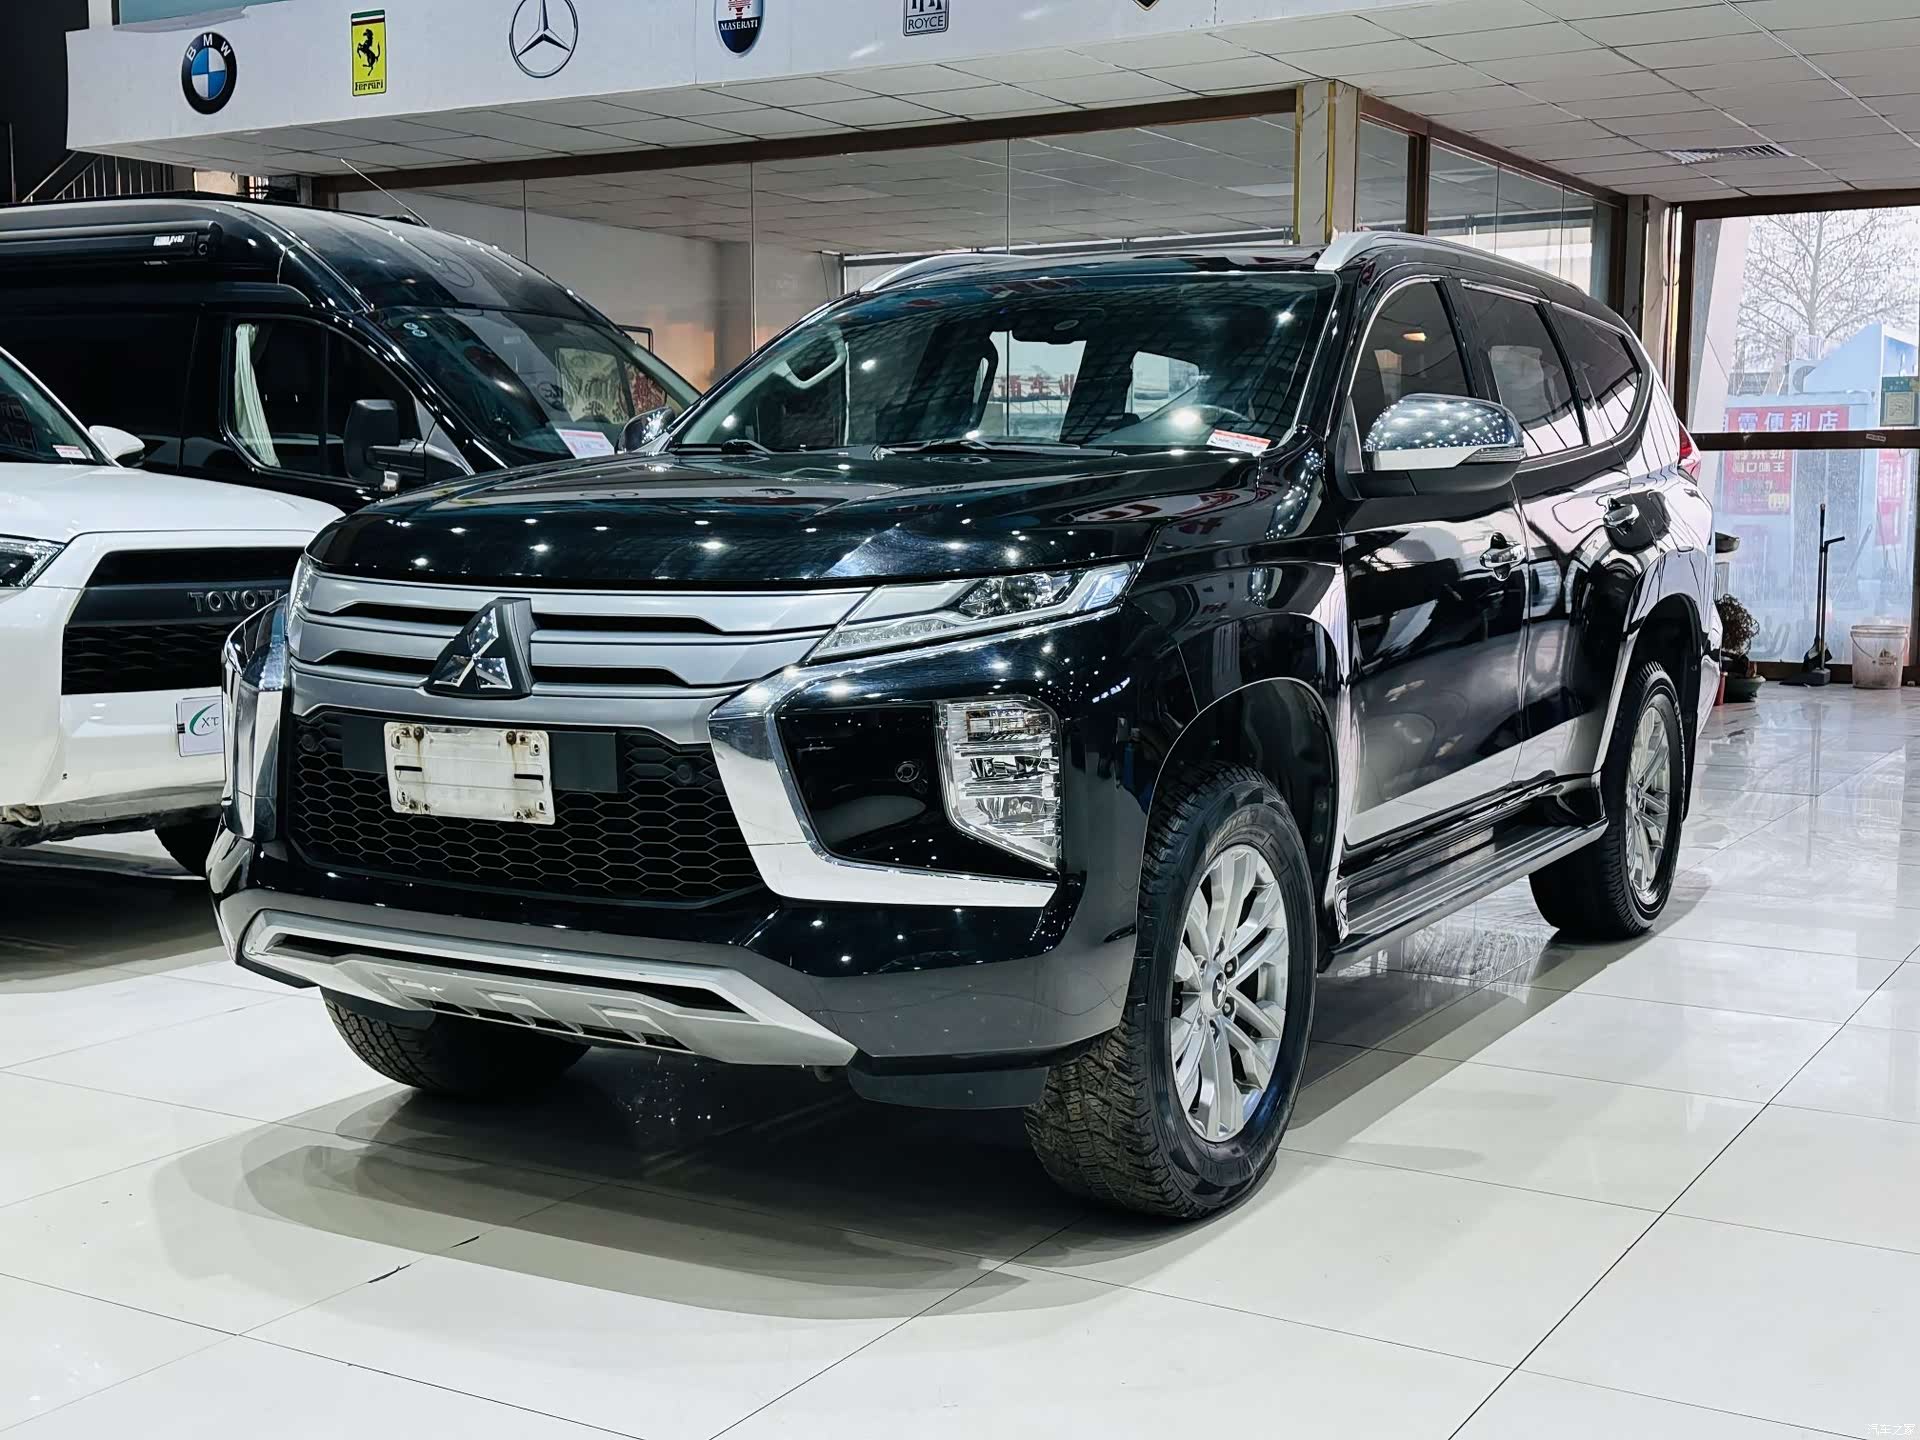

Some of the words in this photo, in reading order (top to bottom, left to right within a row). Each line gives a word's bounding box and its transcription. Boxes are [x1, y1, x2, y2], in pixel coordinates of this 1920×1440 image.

[908, 15, 944, 30] ROYCE
[186, 33, 231, 62] BMW
[355, 80, 383, 91] Ferrari
